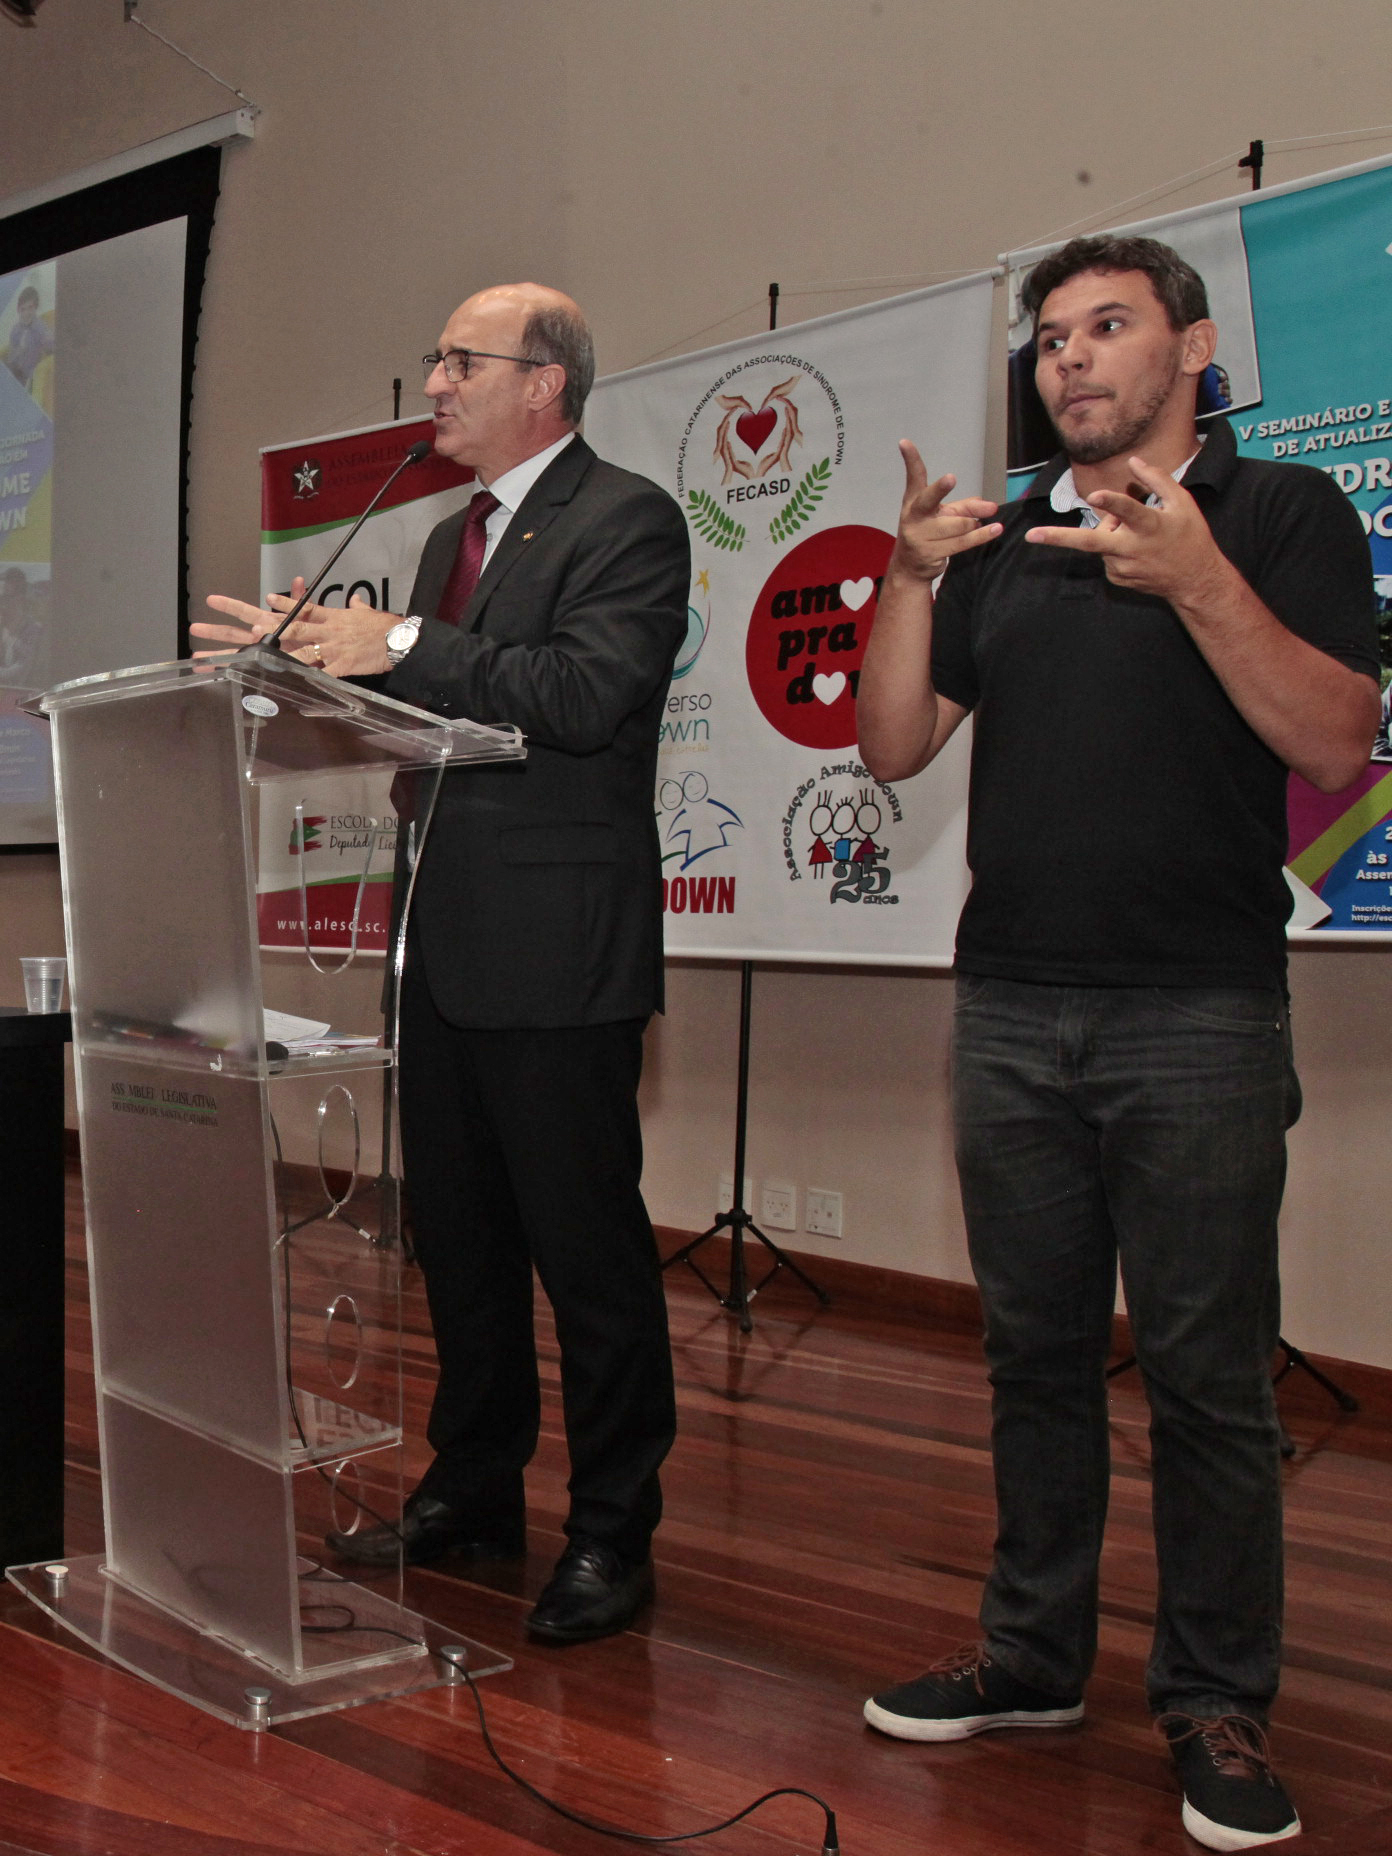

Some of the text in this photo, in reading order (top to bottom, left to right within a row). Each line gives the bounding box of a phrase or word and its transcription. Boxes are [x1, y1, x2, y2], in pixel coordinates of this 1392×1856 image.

[676, 354, 845, 498] FEDERAÇÃO CATARINENSE DAS ASSOCIAÇÕES DE SÍNDROME DE DOWN
[1239, 425, 1255, 441] V
[1258, 402, 1373, 438] SEMINÁRIO
[1273, 421, 1392, 457] DE ATUALIZ
[726, 478, 791, 504] FECASD
[777, 622, 858, 671] pra
[666, 693, 712, 713] erso
[329, 833, 370, 856] Deputad
[1366, 850, 1388, 865] às
[830, 847, 891, 904] 25
[162, 1088, 217, 1110] LEGISLATIVA
